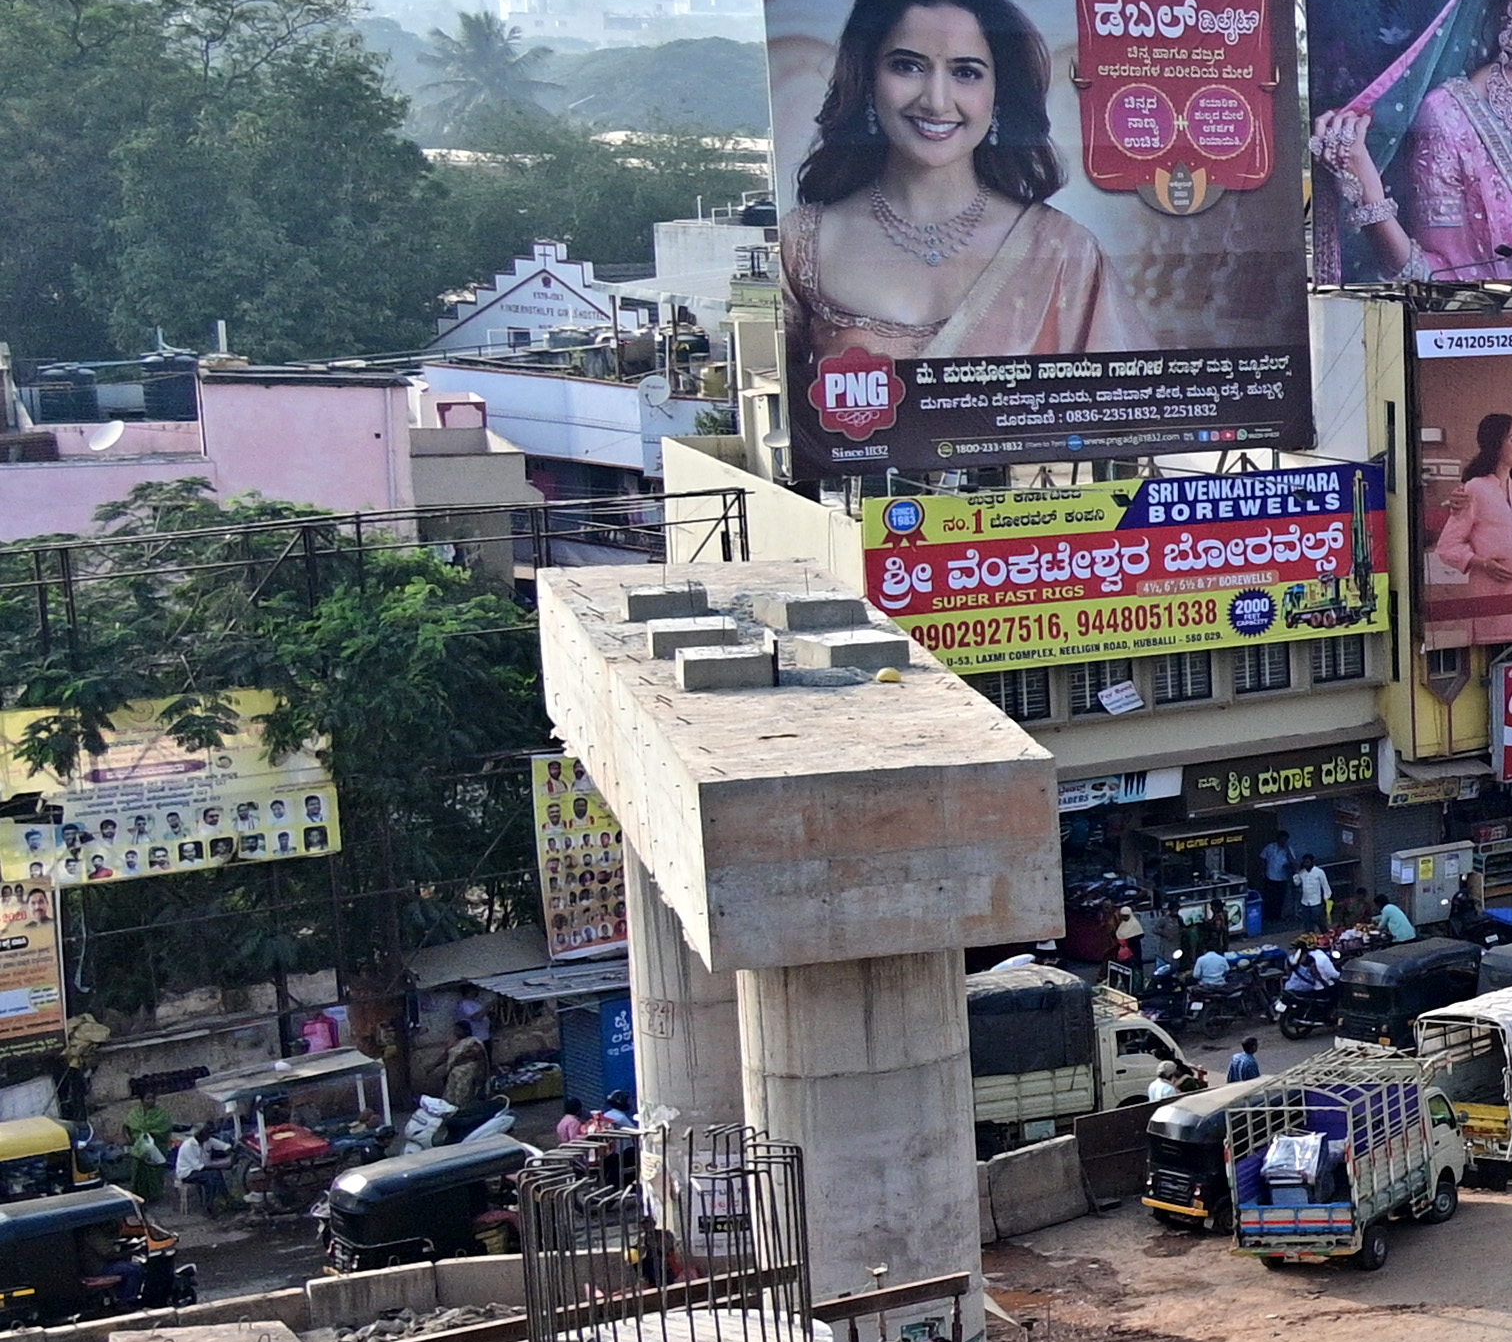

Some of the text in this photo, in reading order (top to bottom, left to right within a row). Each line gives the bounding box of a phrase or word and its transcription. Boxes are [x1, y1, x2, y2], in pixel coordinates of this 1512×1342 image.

[1128, 46, 1225, 65] ಚಿನ್ನ ಹಾಗೂ ವಜ್ರದ
[1223, 65, 1253, 79] ಮೇಲೆ
[1124, 96, 1157, 115] ಚಿನ್ನದ
[943, 358, 1234, 388] ಪುರುಷೋತ್ತಮ ನಾರಾಯಣ ಮತ್ತು
[824, 371, 889, 408] PNG
[920, 393, 988, 410] ದುರ್ಗಾದೇವಿ
[996, 404, 1217, 427] ದೂರವಾಣಿ 0836-2351832, 2251832
[1148, 471, 1340, 505] SRI VENKATESHWARA
[990, 507, 1105, 529] ಬೋರವೆಲ್ ಕಂಪನಿ
[1148, 493, 1341, 524] BOREWELLS
[891, 515, 917, 527] 1983
[879, 521, 1345, 609] ಶ್ರೀ ವೆಂಕಟೇಶ್ವರ ಬೋರವೆಲ್ಸ್
[1219, 573, 1273, 588] BOREWELLS
[932, 585, 1085, 609] SUPER FAST RIGS
[1234, 598, 1270, 614] 2000
[1077, 599, 1218, 636] 9448051338
[976, 640, 1130, 665] LAXMI COMPLEX, ROAD,
[1226, 755, 1374, 804] ಶ್ರೀ ದುರ್ಗಾ ದರ್ಶಿನಿ
